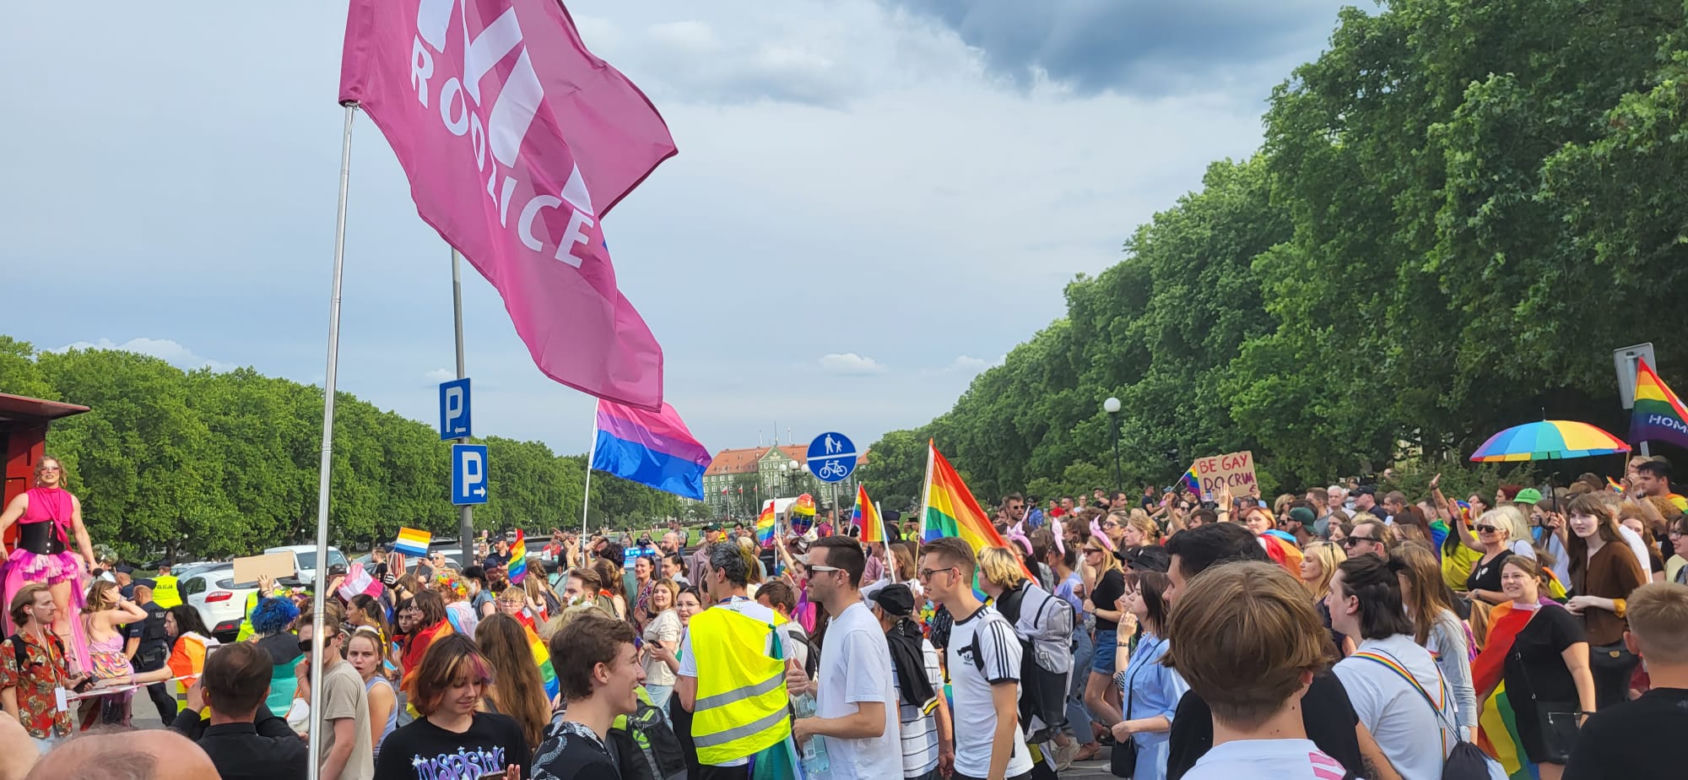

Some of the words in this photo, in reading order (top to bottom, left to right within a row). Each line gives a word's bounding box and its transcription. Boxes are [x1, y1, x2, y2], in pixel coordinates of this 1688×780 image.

[445, 386, 463, 433] P
[1648, 414, 1688, 433] HOM
[461, 451, 483, 497] P
[1199, 459, 1217, 474] BE
[1222, 455, 1248, 471] GAY
